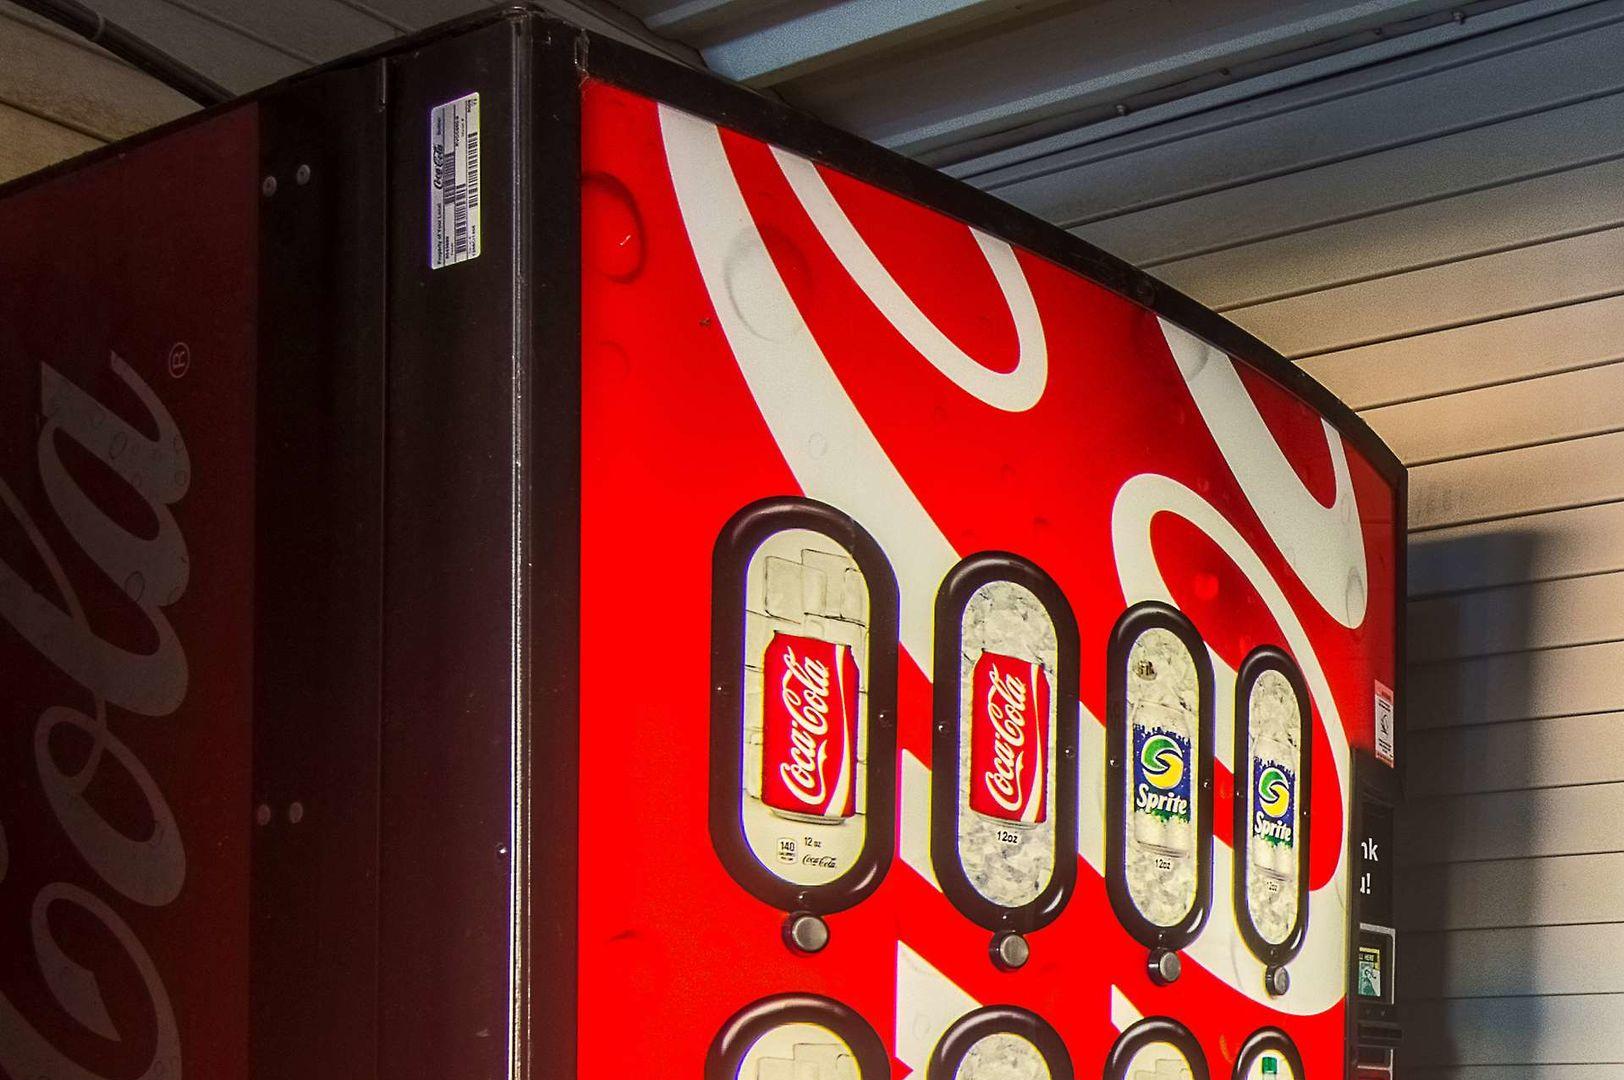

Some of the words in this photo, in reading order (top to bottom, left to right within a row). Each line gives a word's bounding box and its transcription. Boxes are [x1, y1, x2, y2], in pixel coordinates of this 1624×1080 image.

[780, 646, 830, 806] Coca-Cola
[985, 663, 1027, 811] Coca-Cola
[1136, 783, 1188, 815] Sprite
[997, 831, 1018, 844] 12oz
[1254, 811, 1292, 841] Sprite
[780, 841, 795, 852] 140
